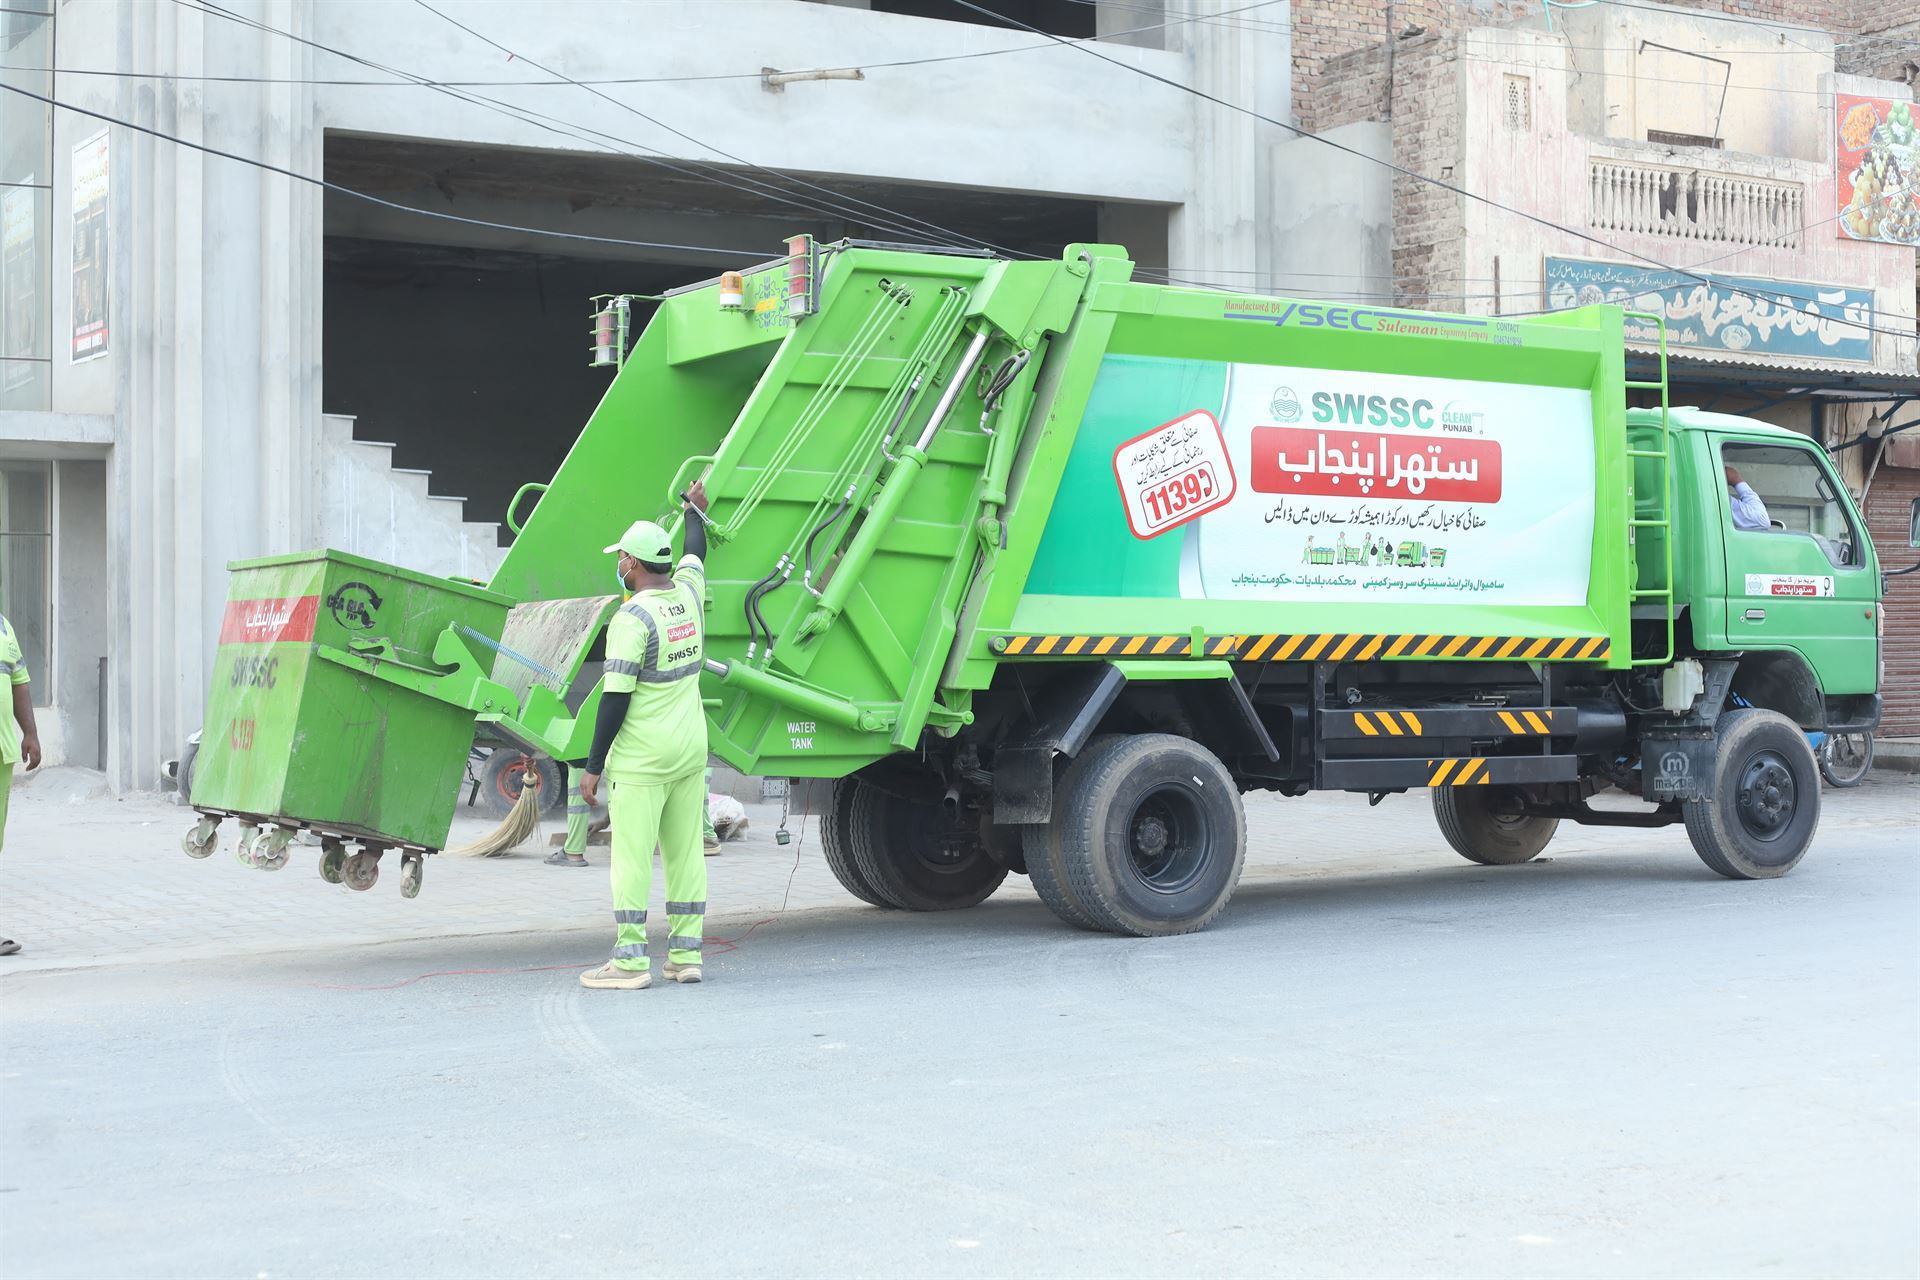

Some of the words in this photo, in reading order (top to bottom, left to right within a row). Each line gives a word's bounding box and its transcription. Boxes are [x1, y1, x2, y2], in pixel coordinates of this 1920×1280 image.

[1376, 318, 1439, 336] Suleman
[1496, 321, 1520, 334] CONTACT
[1311, 391, 1435, 430] SWSSC
[1441, 410, 1472, 425] CLEAN
[1442, 423, 1473, 433] PUNJAB
[1278, 432, 1375, 494] پنجاب
[1379, 436, 1478, 495] ستھرا
[1146, 473, 1202, 521] 1139
[1293, 505, 1311, 525] میں
[1395, 510, 1411, 527] اور
[1410, 504, 1435, 529] رکھیں
[1433, 510, 1455, 532] خیال
[1455, 510, 1467, 528] کا
[1463, 507, 1487, 531] صفائی
[231, 655, 278, 689] SWSSC
[786, 721, 816, 734] WATER
[790, 737, 813, 750] TANK
